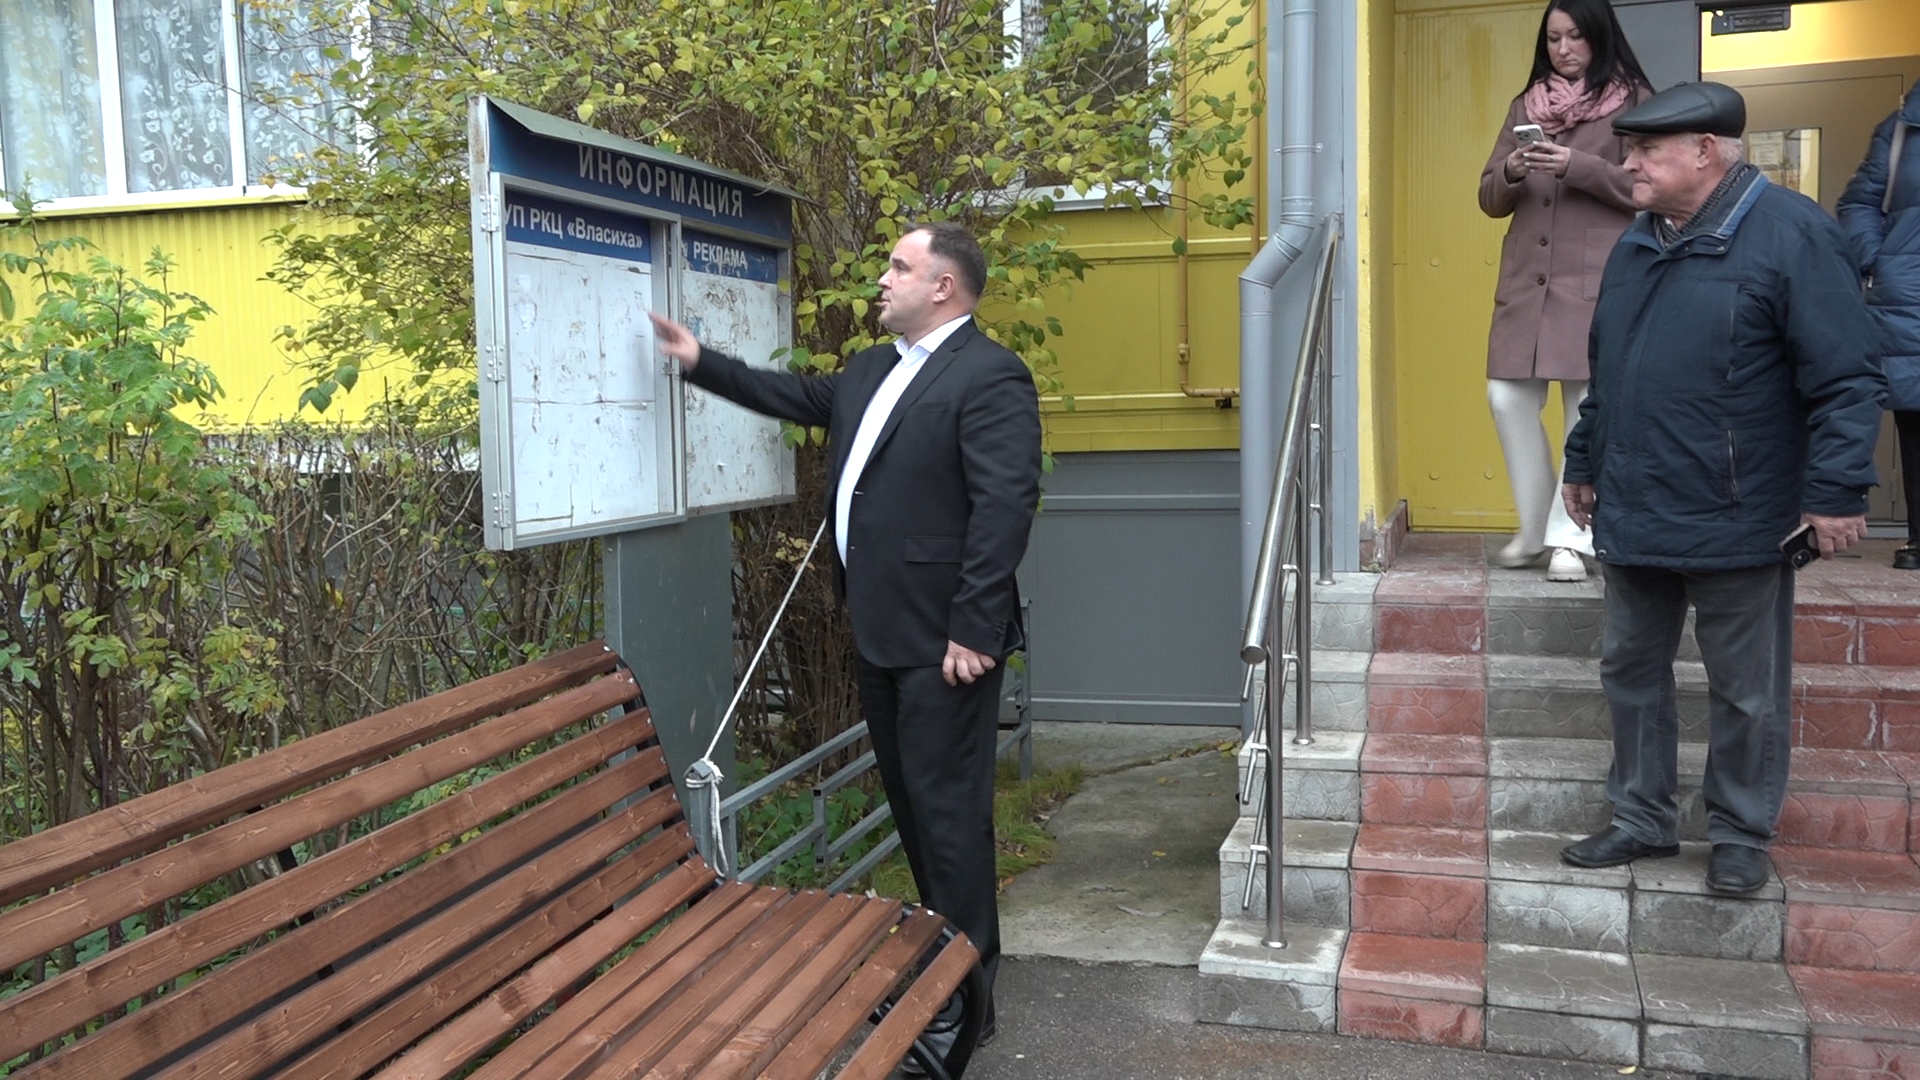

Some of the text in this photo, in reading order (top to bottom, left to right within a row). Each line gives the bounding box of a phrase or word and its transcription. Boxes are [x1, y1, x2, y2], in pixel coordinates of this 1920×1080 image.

[579, 144, 743, 218] ИНФОРМАЦИЯ
[530, 208, 563, 240] РКЦ
[567, 217, 643, 249] «Власиха»
[693, 241, 748, 269] РЕКЛАМА
